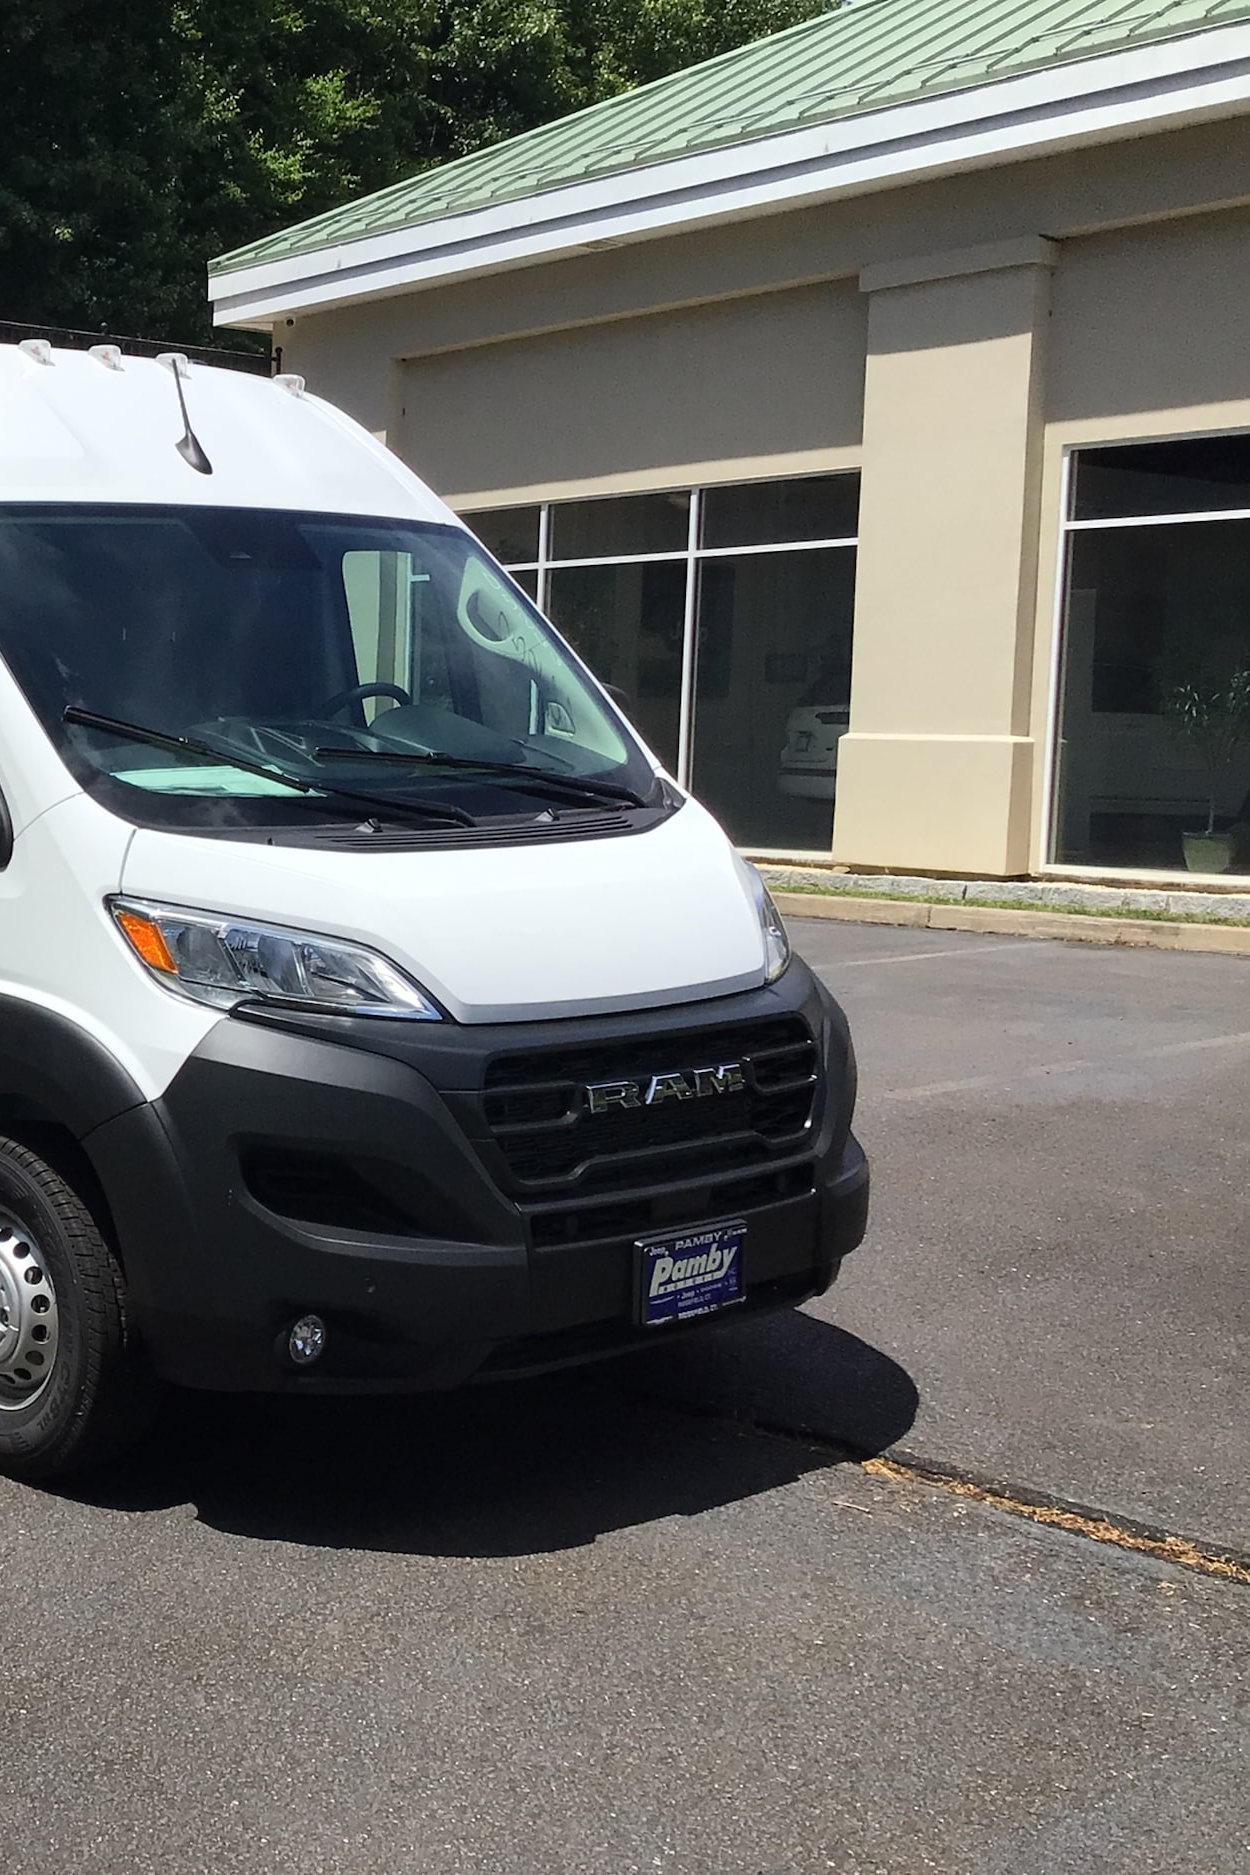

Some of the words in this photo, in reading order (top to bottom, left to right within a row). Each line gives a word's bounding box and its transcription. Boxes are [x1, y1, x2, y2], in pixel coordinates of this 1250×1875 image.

[584, 1063, 744, 1114] RAM
[675, 1231, 723, 1251] PAMBY
[648, 1243, 738, 1298] Pamby
